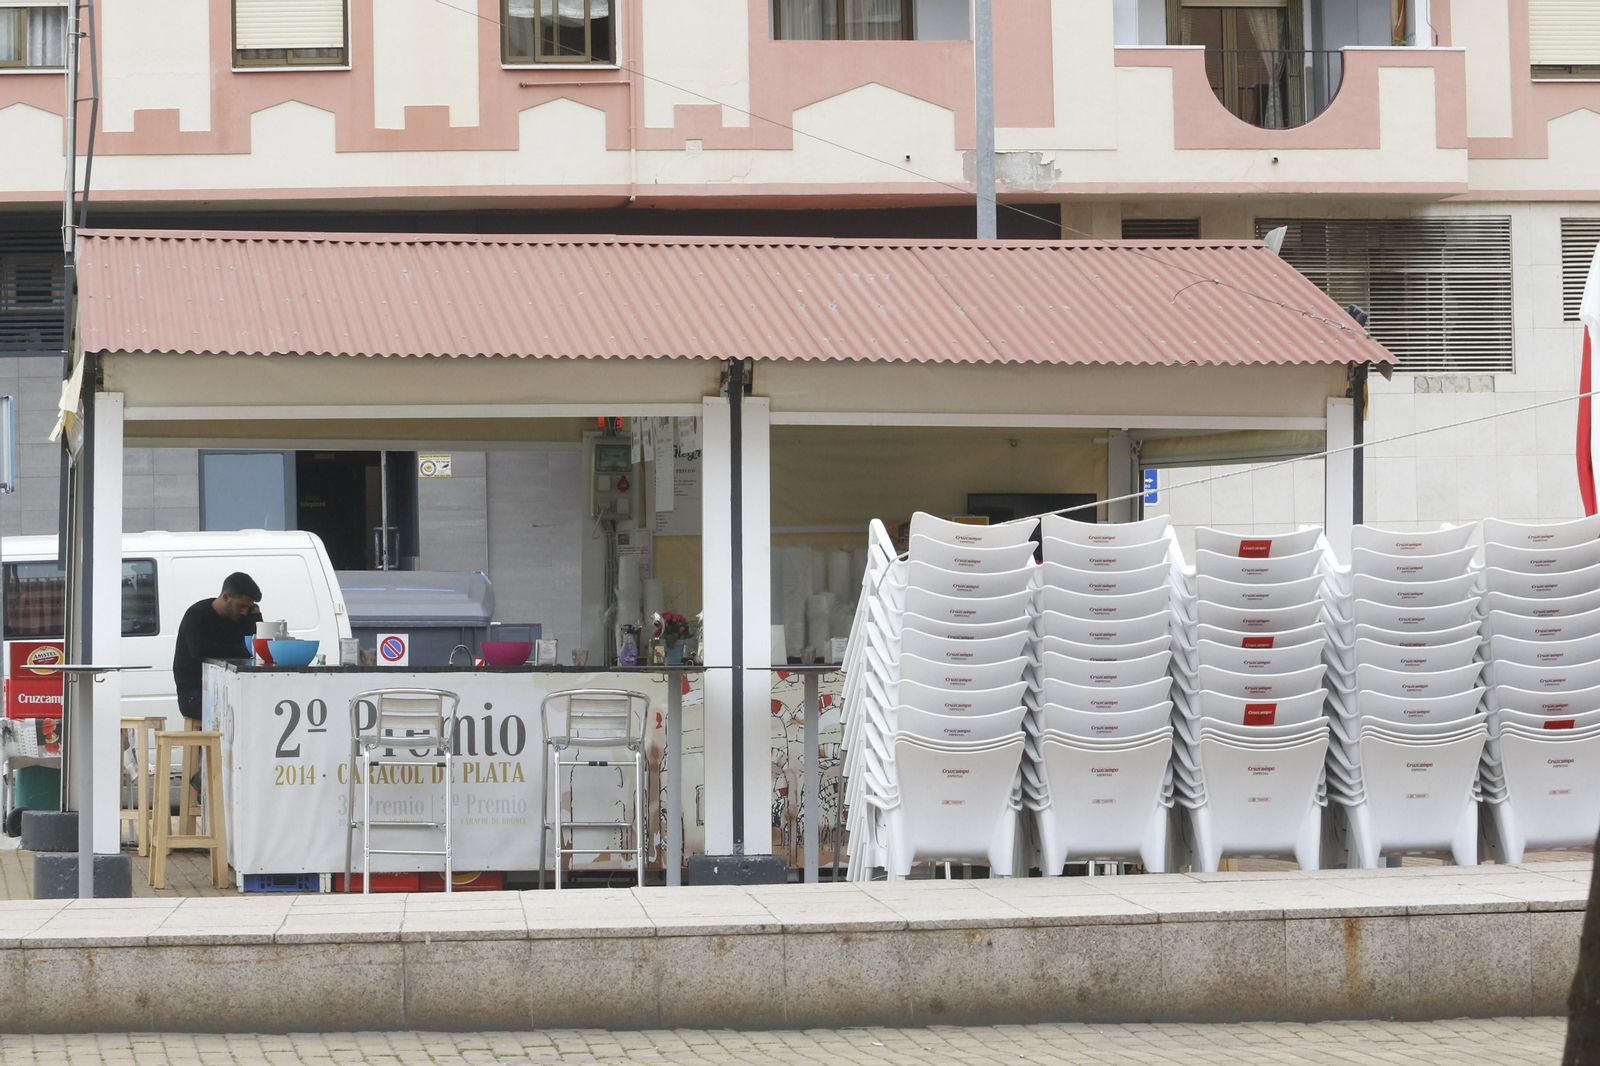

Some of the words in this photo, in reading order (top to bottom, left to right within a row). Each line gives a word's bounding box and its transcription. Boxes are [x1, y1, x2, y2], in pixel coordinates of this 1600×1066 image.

[33, 651, 57, 660] AMSTEL
[274, 698, 328, 758] 2º
[275, 764, 316, 786] 2014
[463, 761, 526, 784] PLATA
[467, 793, 527, 815] Premio
